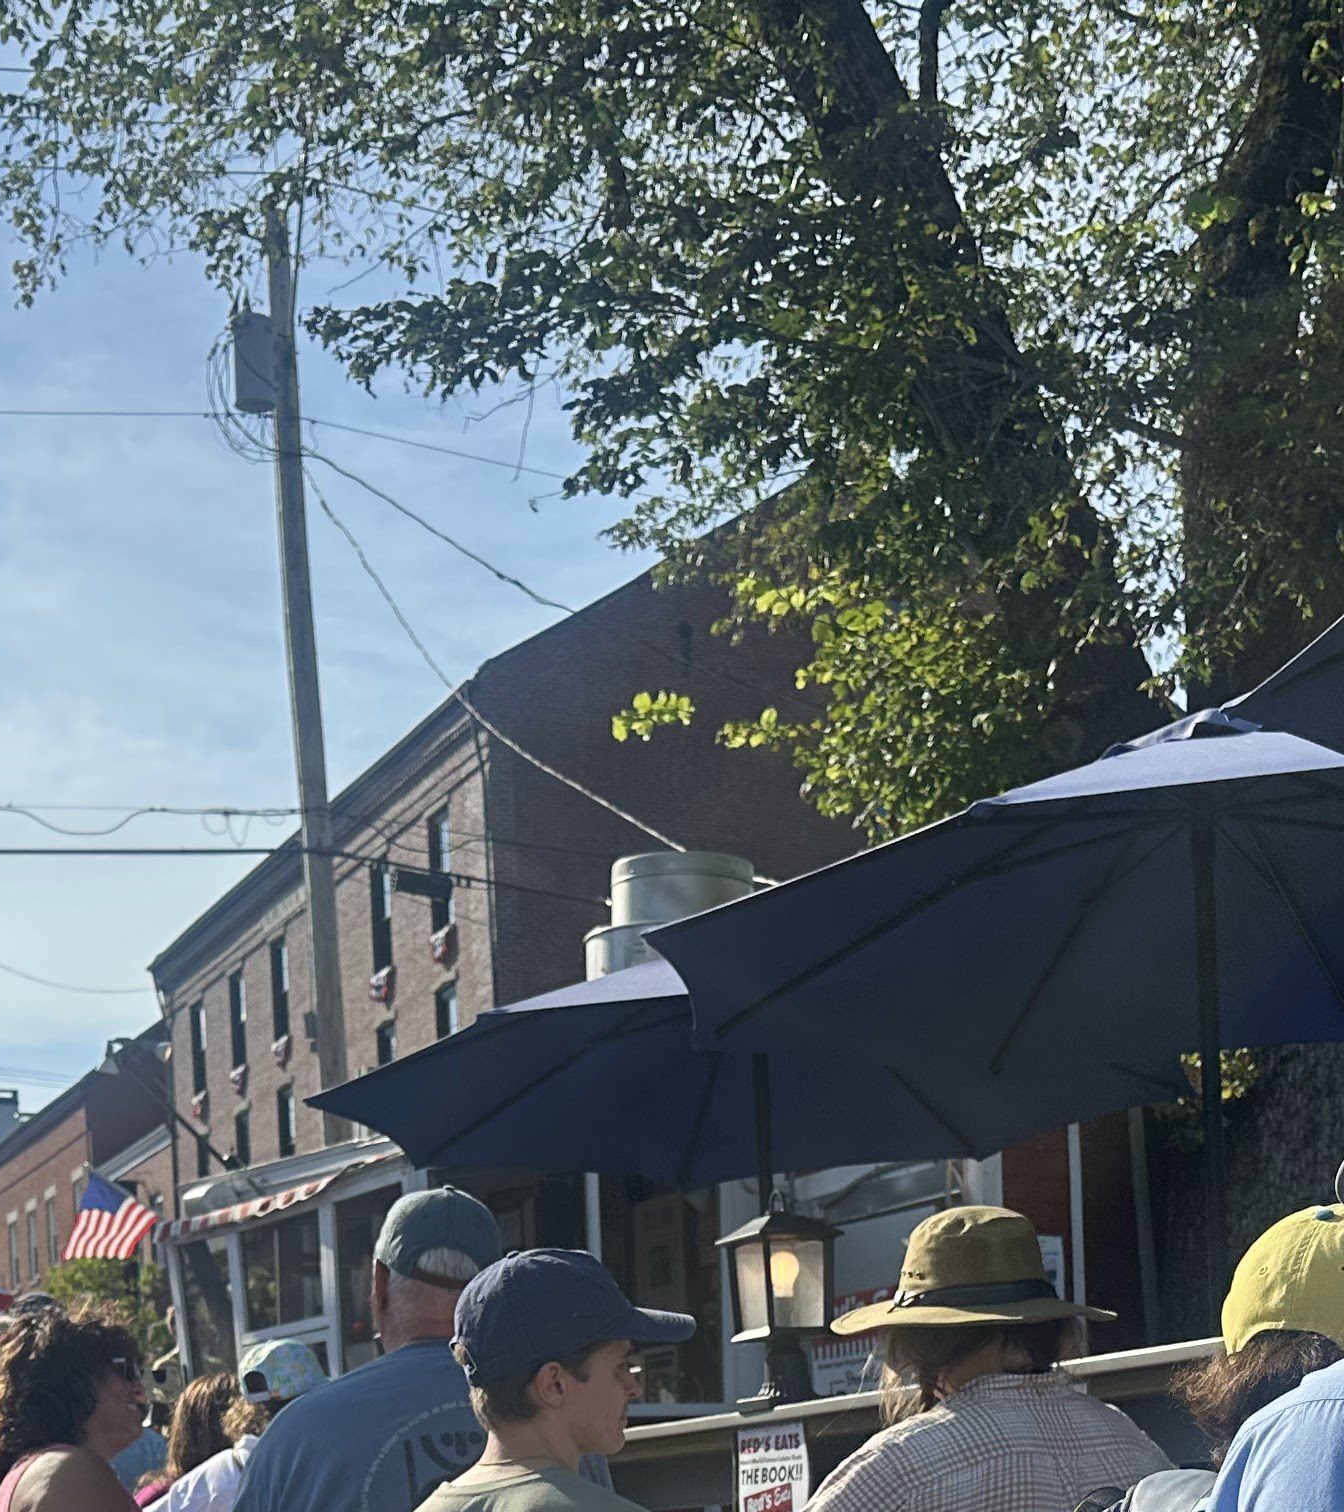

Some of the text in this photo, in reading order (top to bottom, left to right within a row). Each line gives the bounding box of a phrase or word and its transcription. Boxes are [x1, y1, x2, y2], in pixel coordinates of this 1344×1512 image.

[740, 1432, 800, 1454] RED'S EATS
[741, 1463, 802, 1486] THE BOOK!!
